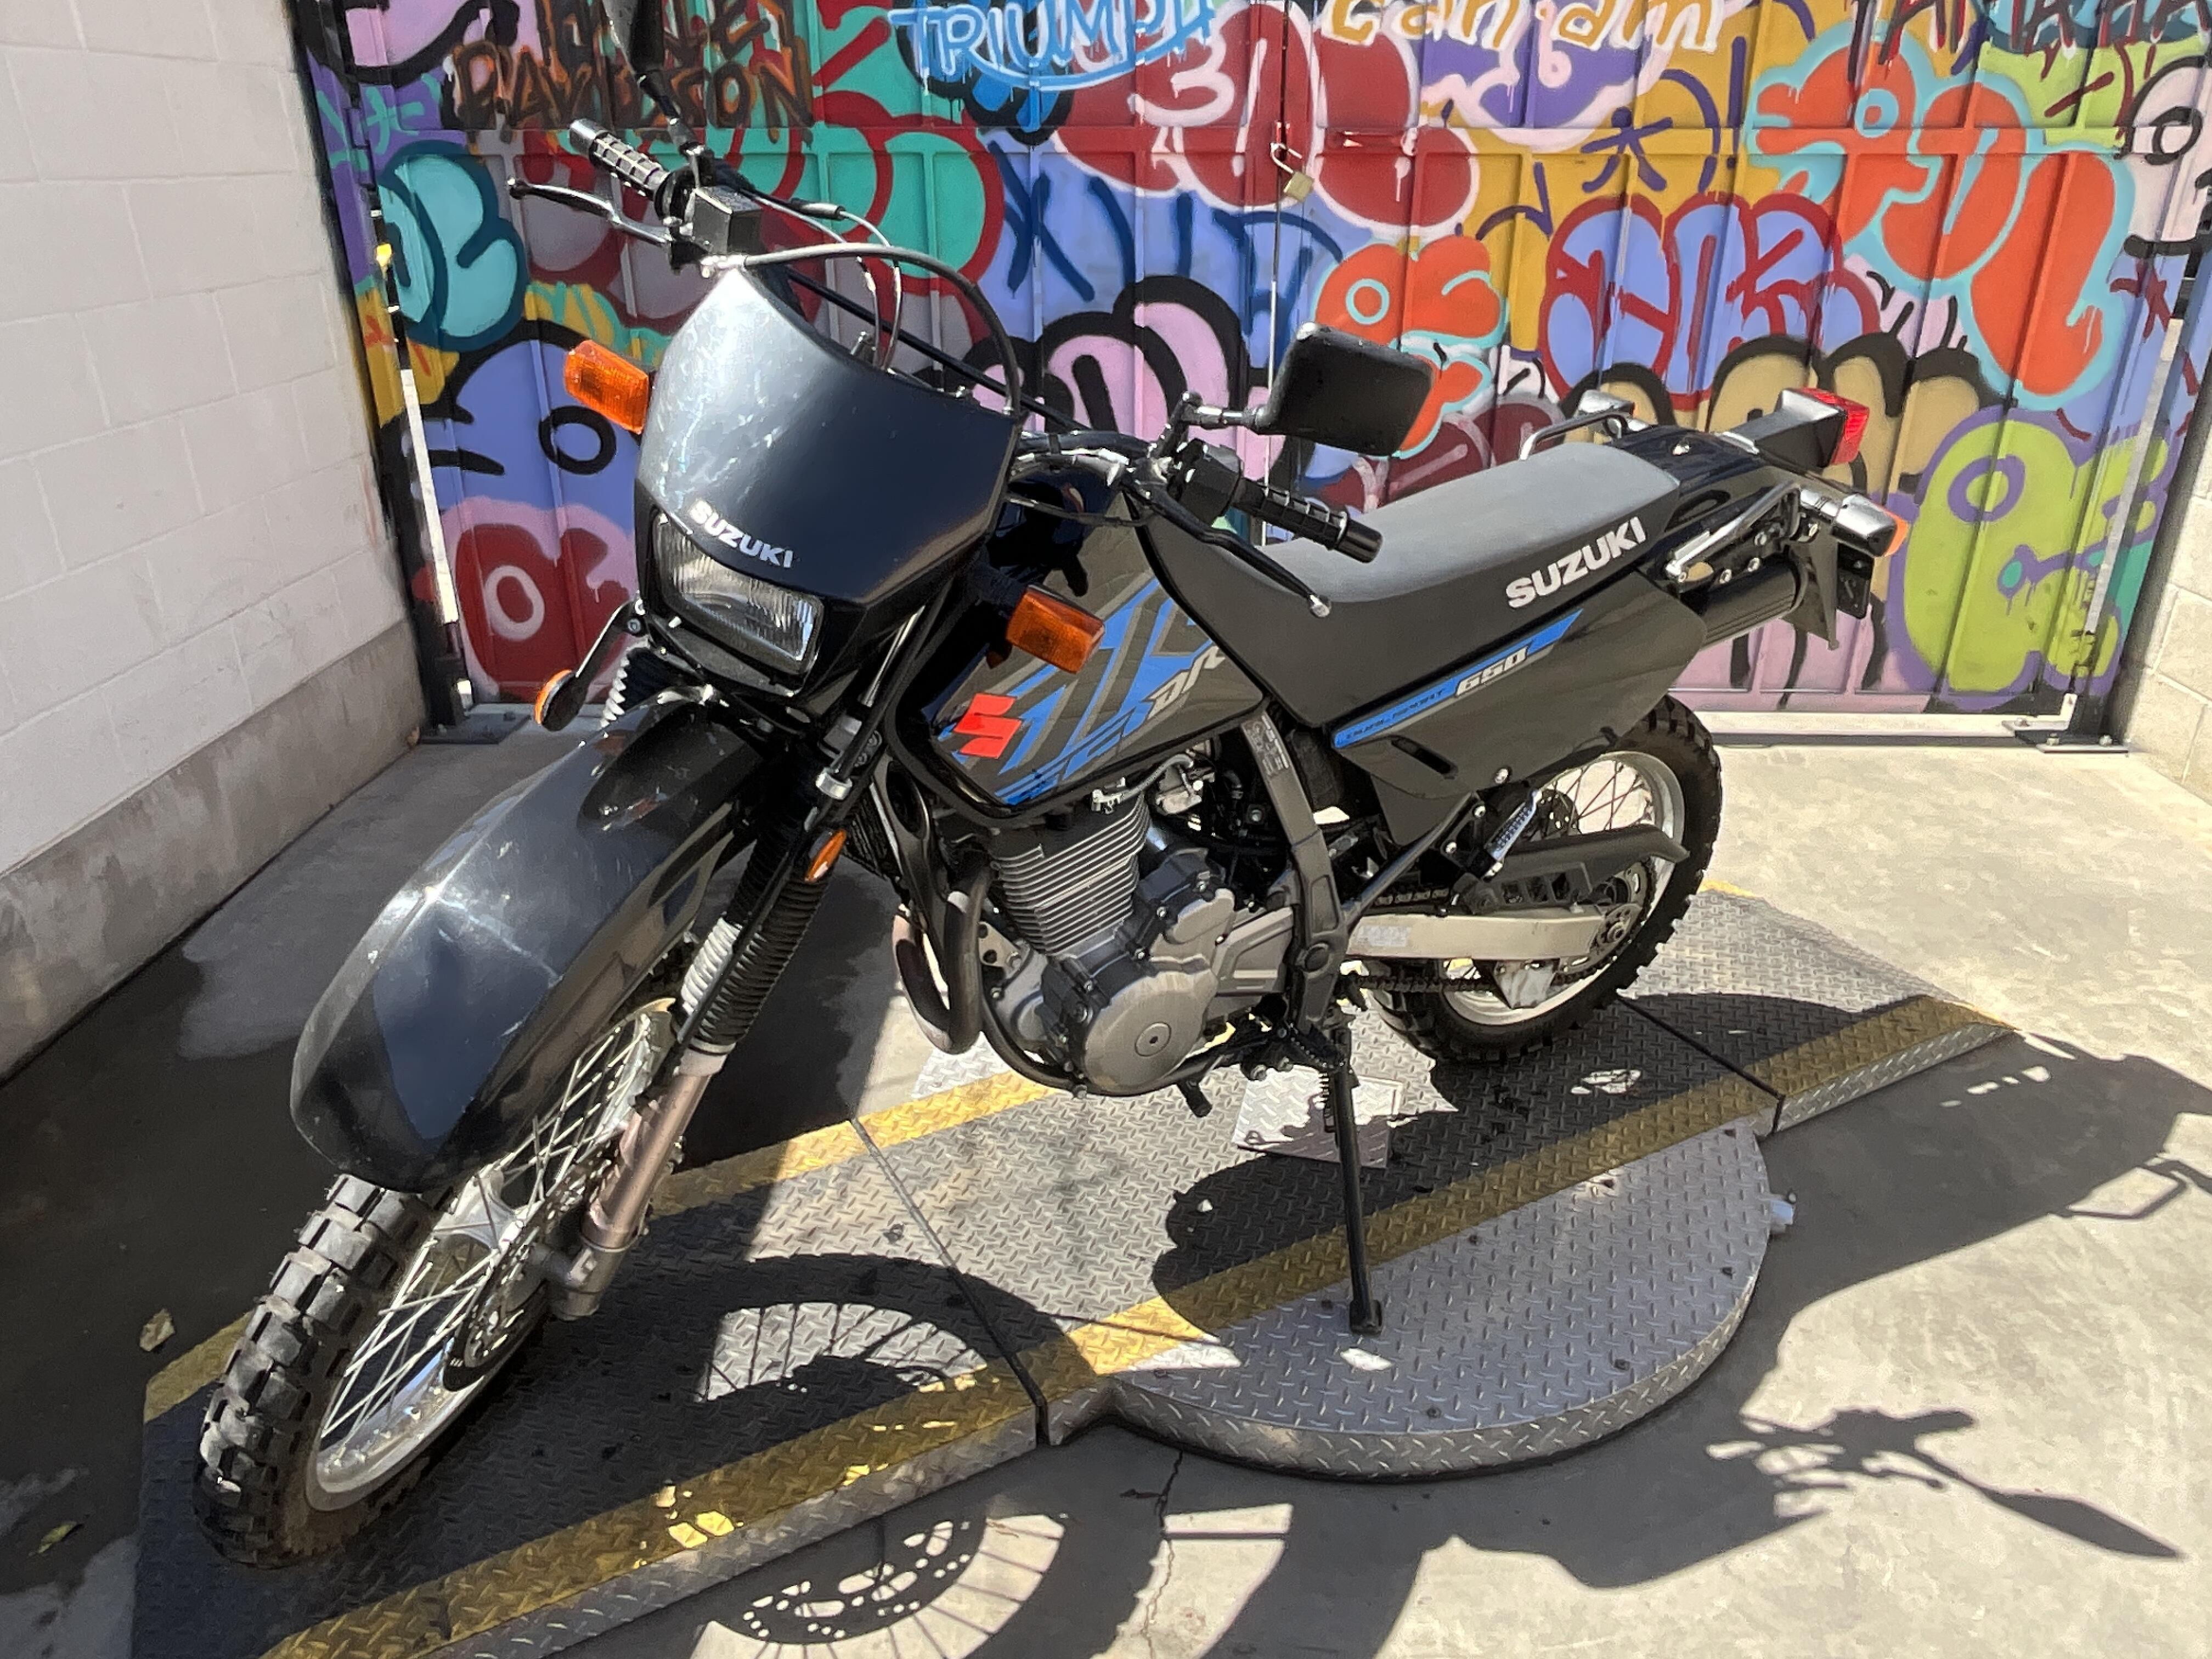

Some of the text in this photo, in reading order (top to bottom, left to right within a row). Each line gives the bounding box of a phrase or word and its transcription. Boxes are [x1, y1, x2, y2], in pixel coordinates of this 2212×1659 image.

[688, 497, 794, 568] SUZUKI
[1505, 516, 1647, 608] SUZUKI
[1457, 645, 1527, 696] 650
